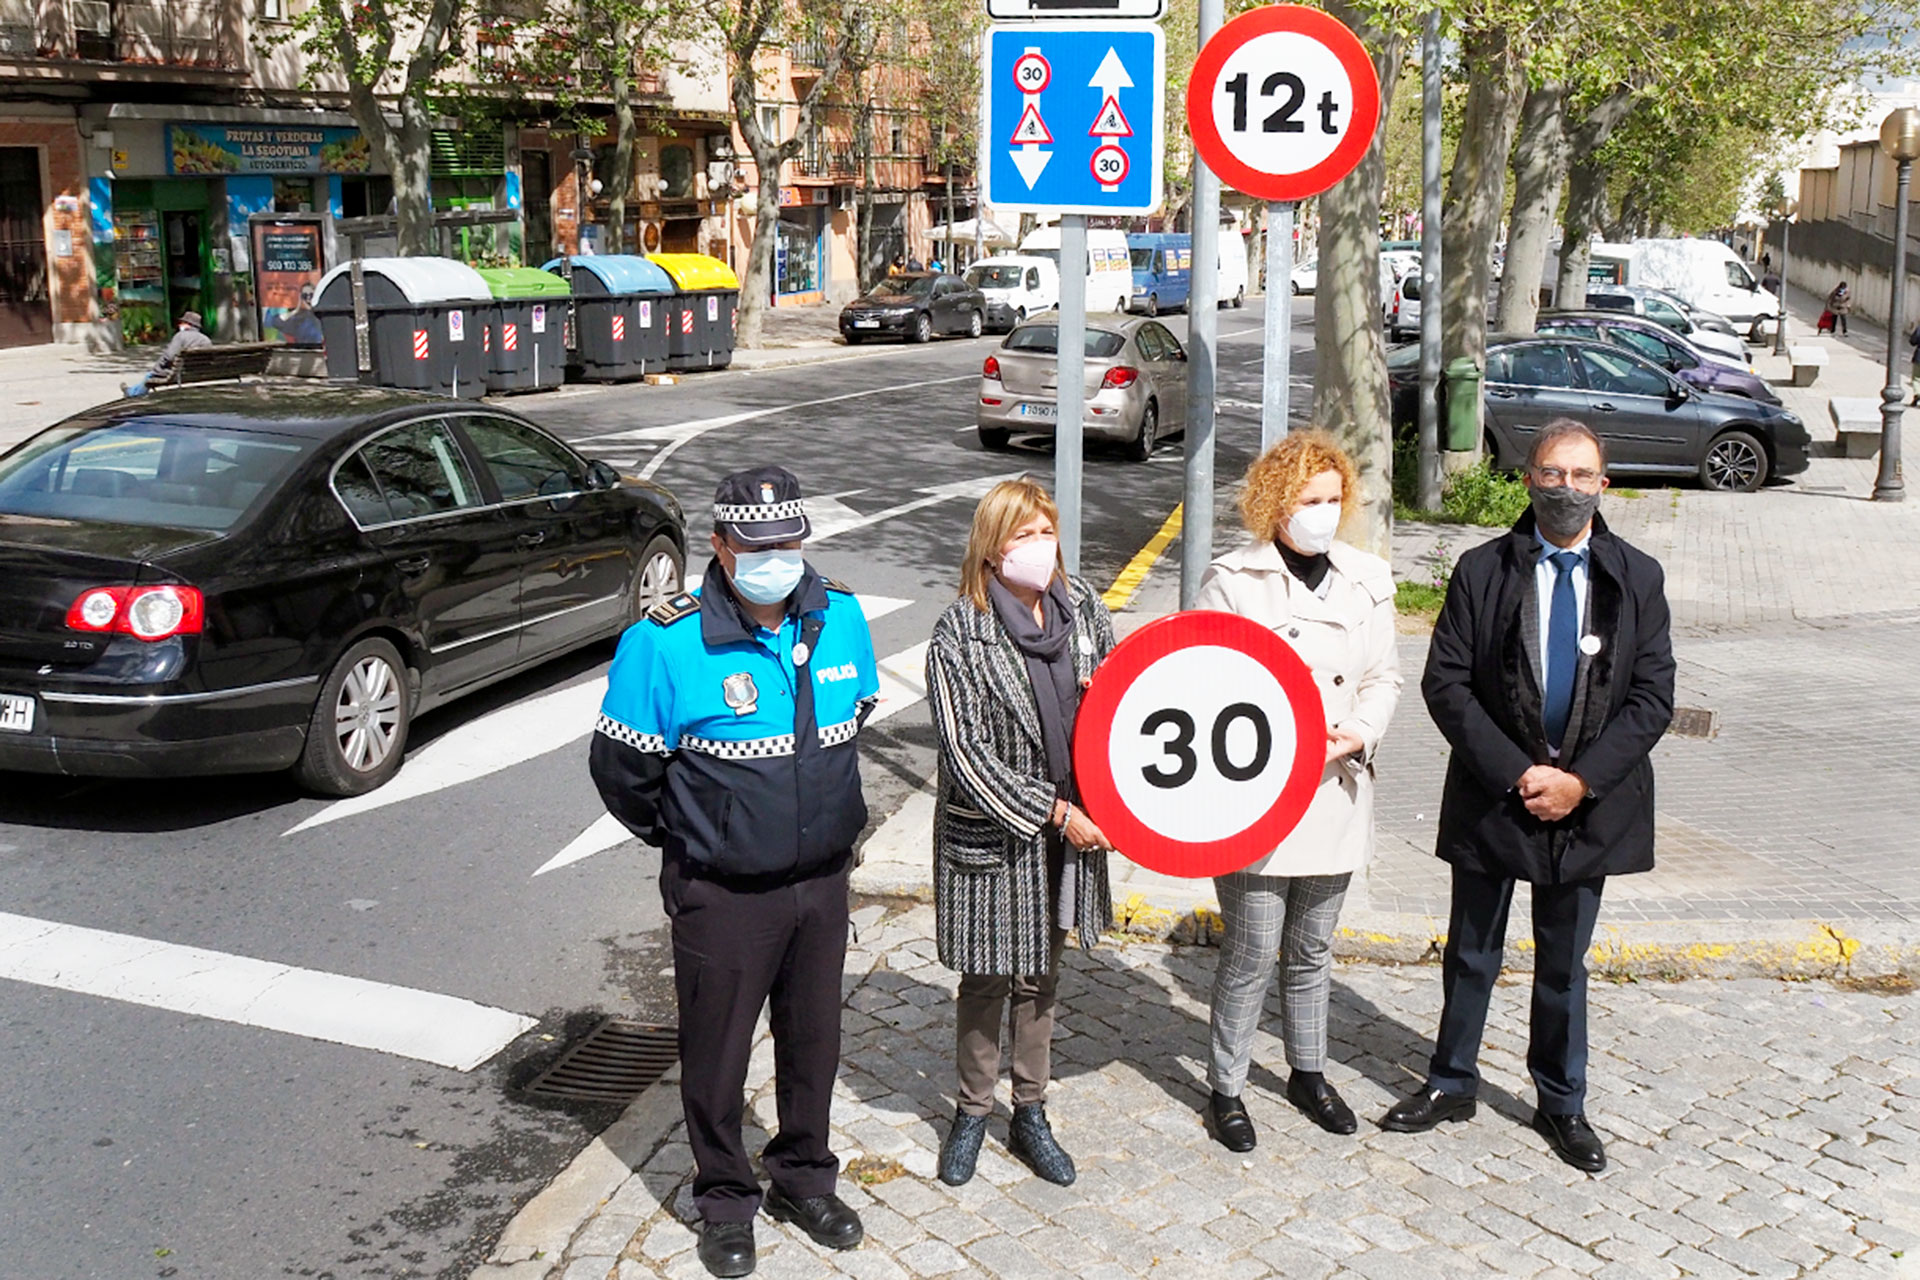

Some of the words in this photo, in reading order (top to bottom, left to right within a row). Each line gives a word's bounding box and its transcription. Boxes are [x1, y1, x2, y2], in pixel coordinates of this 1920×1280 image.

[1022, 66, 1043, 81] 30
[226, 130, 264, 142] FRUTAS
[265, 132, 273, 142] Y
[275, 131, 324, 143] VERDURAS
[241, 144, 254, 156] LA
[249, 160, 308, 170] AUTOSERVICIO
[1099, 158, 1120, 173] 30
[1140, 702, 1272, 789] 30
